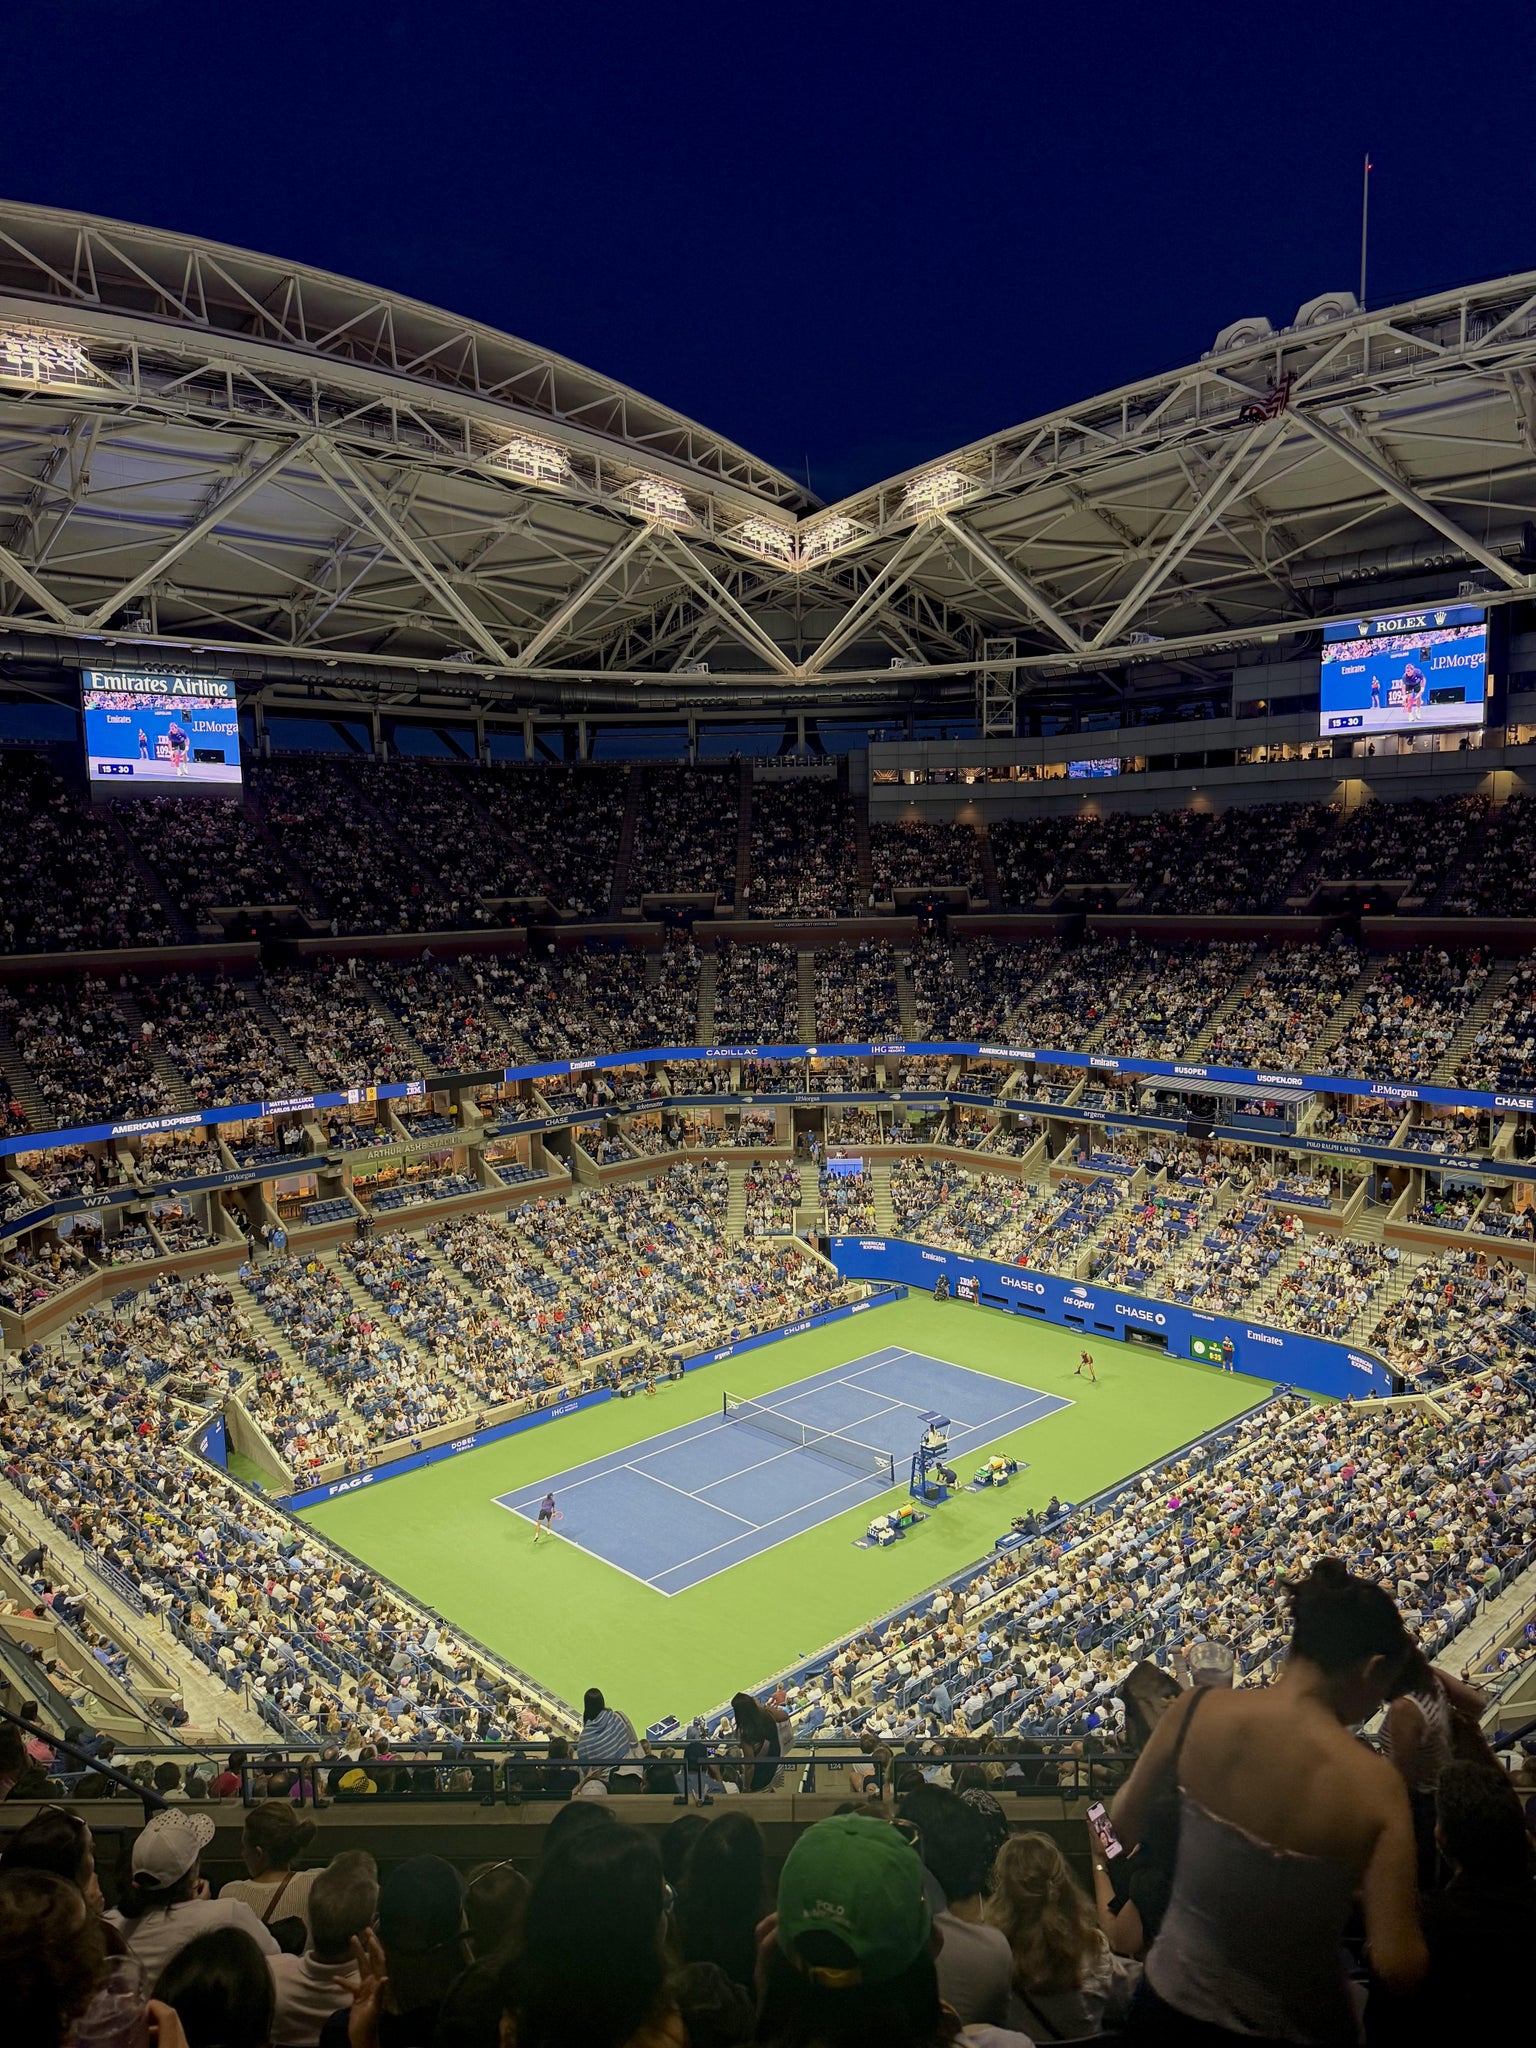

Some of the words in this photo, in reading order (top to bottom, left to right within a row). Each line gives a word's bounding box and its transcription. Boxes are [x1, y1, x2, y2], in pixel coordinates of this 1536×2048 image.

[1376, 616, 1427, 632] ROLEX
[1430, 653, 1485, 670] J.P.Morga
[1341, 664, 1366, 675] Emirates
[91, 672, 168, 693] Emirates
[172, 677, 228, 697] Airline
[106, 715, 132, 724] Emirates
[1332, 719, 1341, 727] 15
[1347, 718, 1359, 726] 30
[192, 720, 238, 736] J.P.Morga
[706, 1048, 758, 1056] CADILLAC
[979, 1047, 1007, 1057] AMERICAN
[1008, 1050, 1036, 1059] EXPRESS
[570, 1060, 596, 1070] Emirates
[1090, 1057, 1119, 1068] Emirates
[1174, 1066, 1207, 1076] #USOPEN
[1257, 1074, 1303, 1086] USOPEN.ORG
[406, 1086, 422, 1095] IBM
[1370, 1085, 1418, 1098] J.P.Morgan
[270, 1106, 290, 1114] CARLOS
[291, 1103, 315, 1111] ALCARAZ
[636, 1101, 664, 1111] ticketmaster
[993, 1099, 1007, 1108] IBM
[1495, 1097, 1534, 1109] CHASE
[111, 1120, 160, 1135] AMERICAN
[161, 1115, 202, 1127] EXPRESS
[545, 1116, 569, 1126] CHASE
[367, 1146, 402, 1159] ARTHUR
[404, 1142, 427, 1153] ASHE
[1340, 1145, 1361, 1153] LAUREN
[223, 1171, 256, 1183] J.P.Morgan
[83, 1195, 111, 1208] WTA
[921, 1250, 947, 1263] Emirates
[1001, 1276, 1034, 1292] CHASE
[1063, 1296, 1074, 1304] us
[1073, 1299, 1095, 1310] open
[1115, 1304, 1154, 1322] CHASE
[784, 1321, 811, 1335] CHUBB
[1247, 1329, 1284, 1347] Emirates
[1347, 1353, 1373, 1370] AMERICAN
[1351, 1360, 1373, 1375] EXPRESS
[551, 1406, 564, 1417] IHG
[451, 1436, 477, 1450] DOBEL
